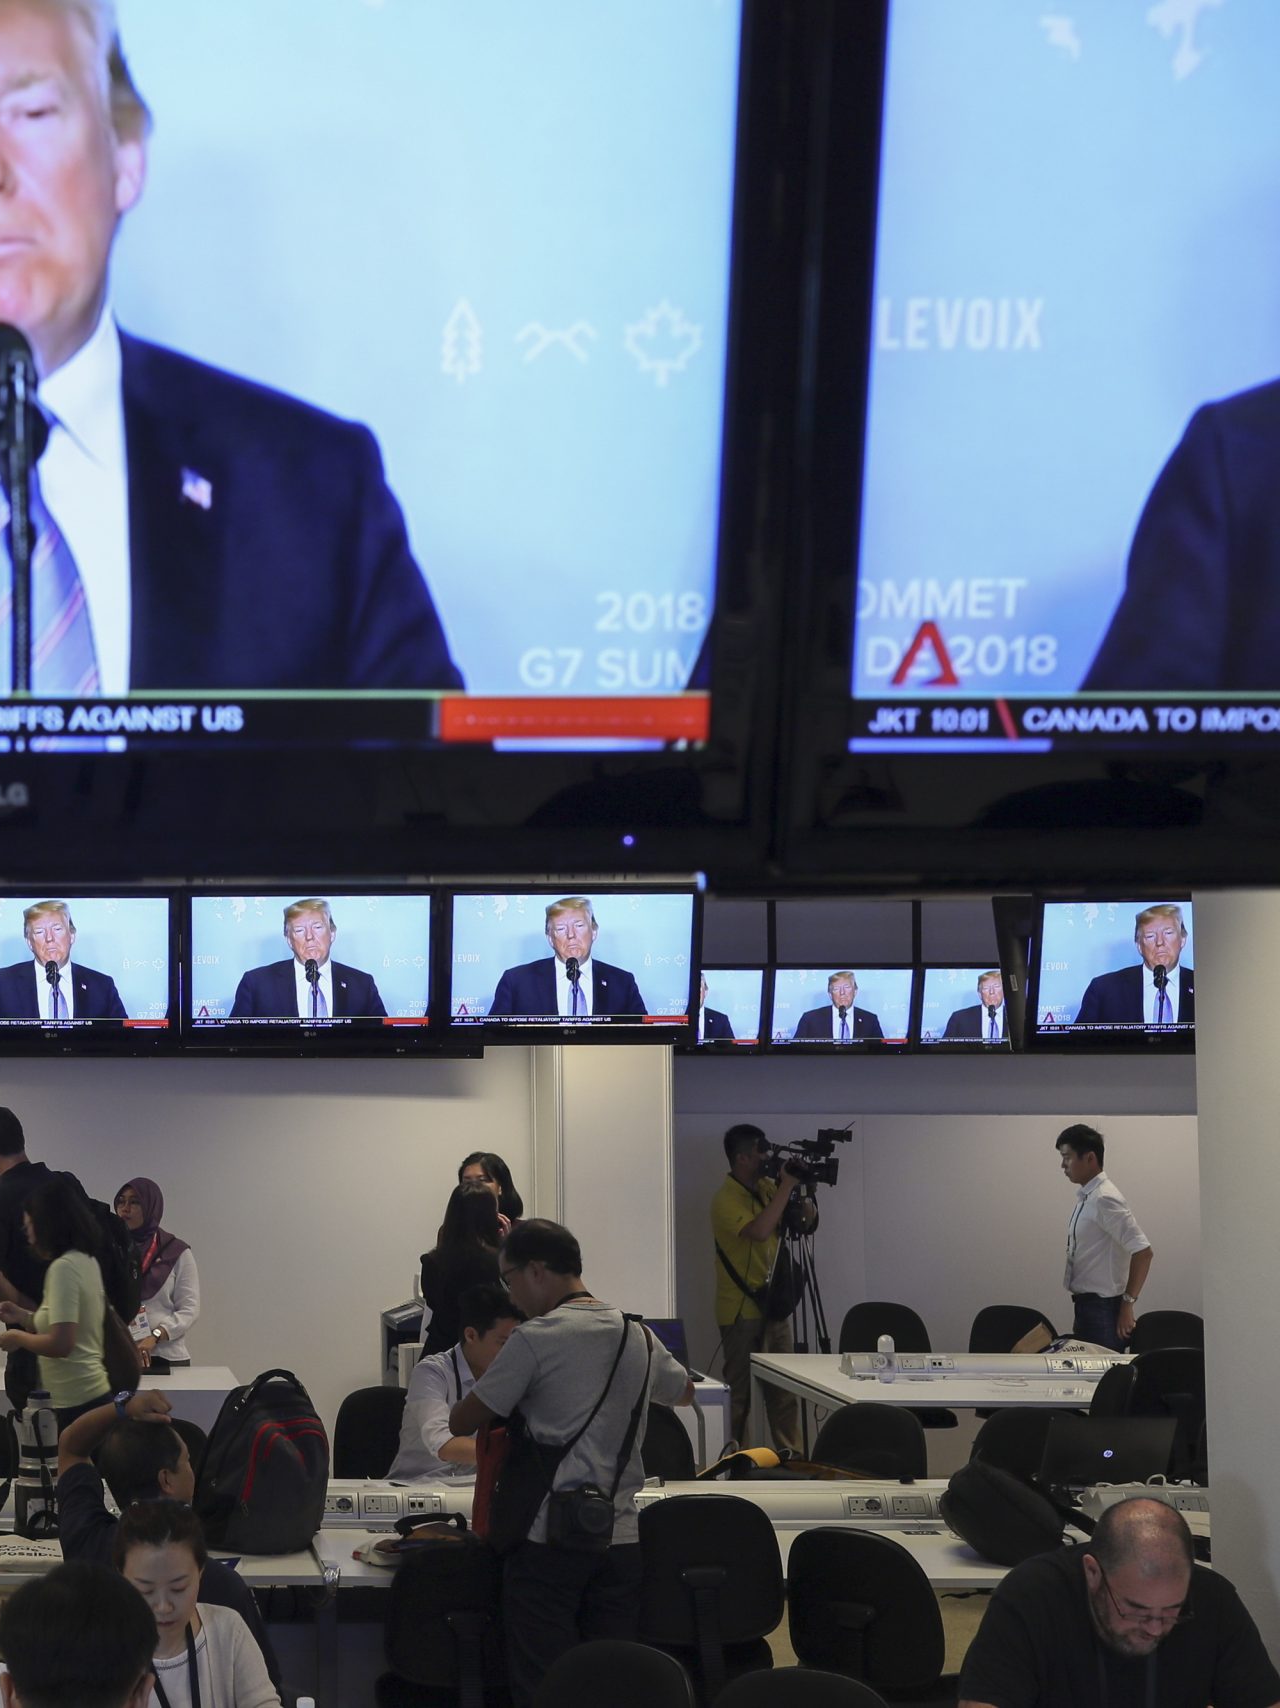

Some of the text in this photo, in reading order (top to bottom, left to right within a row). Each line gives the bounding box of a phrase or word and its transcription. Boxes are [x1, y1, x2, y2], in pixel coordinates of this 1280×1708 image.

[878, 296, 1045, 350] LEVOIX
[594, 592, 707, 633] 2018
[519, 648, 583, 688] G7
[952, 634, 1058, 676] 2018
[68, 706, 197, 732] AGAINST
[201, 706, 244, 732] US
[868, 707, 921, 733] JKT
[1023, 707, 1280, 733] CANADA TO IMPO
